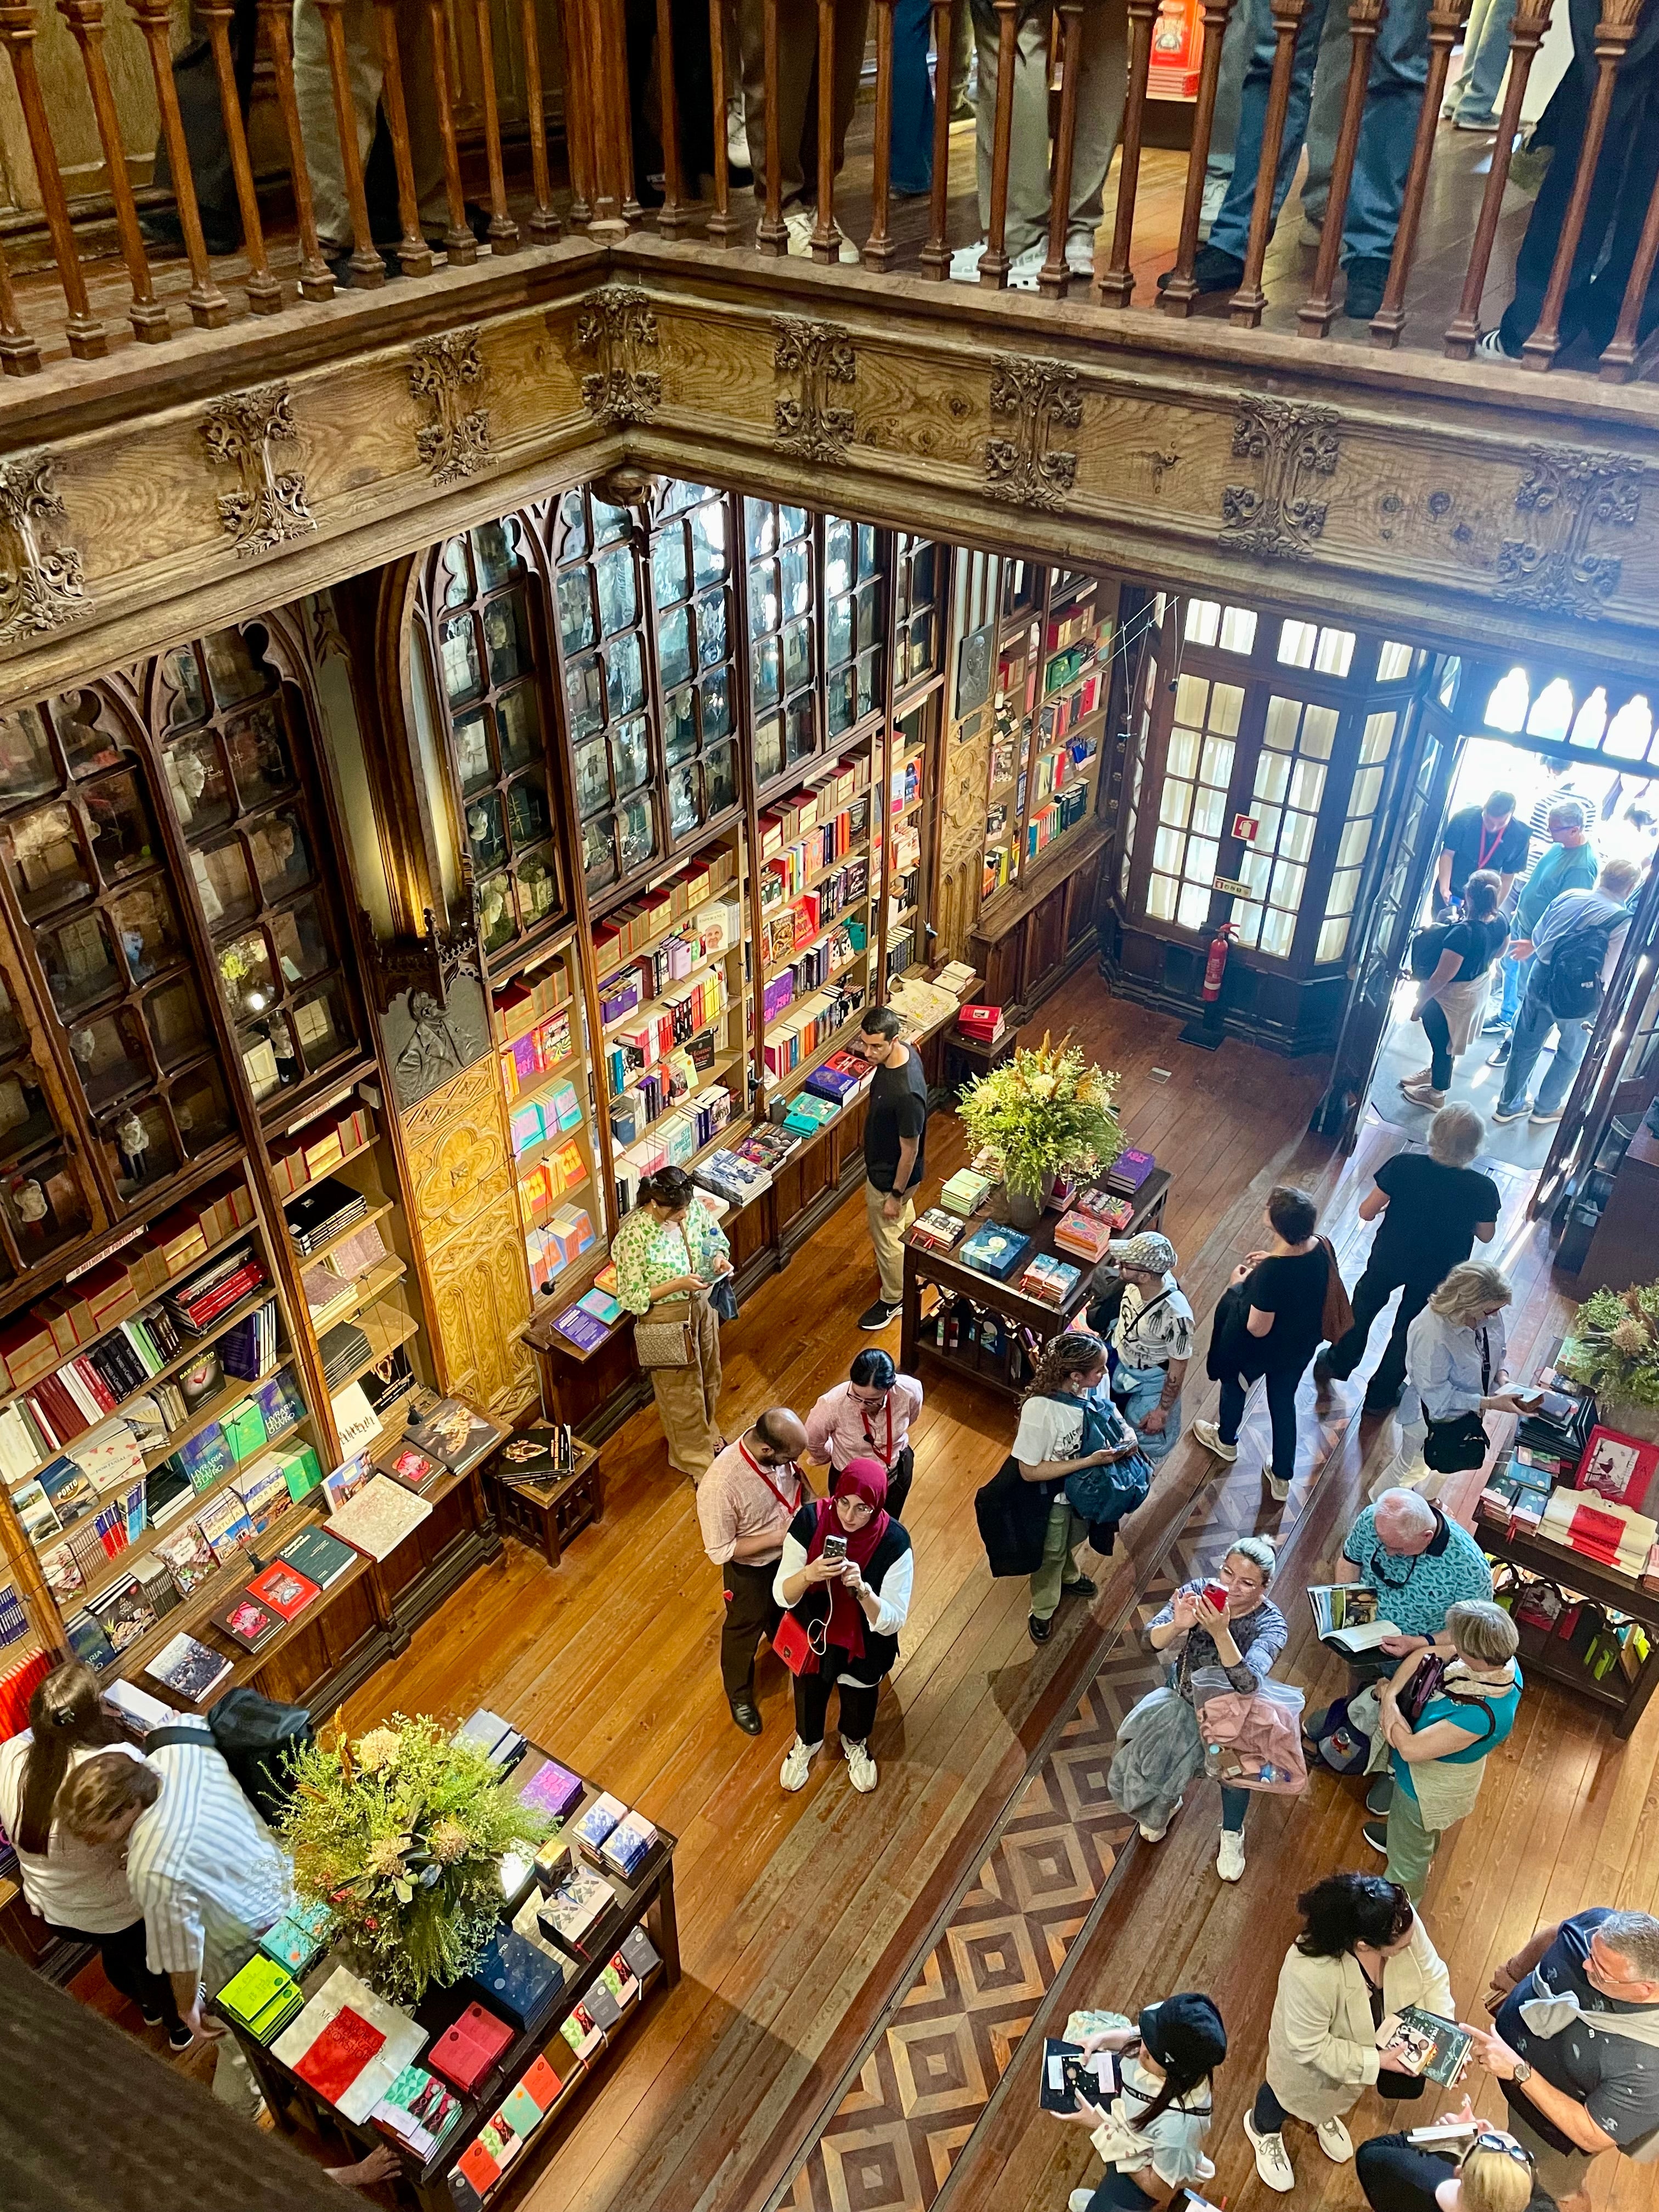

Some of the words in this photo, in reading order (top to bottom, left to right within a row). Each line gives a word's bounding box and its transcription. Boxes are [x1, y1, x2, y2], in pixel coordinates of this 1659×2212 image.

[81, 1254, 103, 1272] MELHOR
[112, 1231, 139, 1251] PORTUGAL
[179, 1368, 193, 1380] BAR
[192, 1351, 215, 1371] ABERTO
[265, 1400, 296, 1425] LIVRARIA
[95, 1455, 127, 1475] PORTUGAL
[190, 1452, 224, 1477] LIVRARIA
[57, 1479, 78, 1500] PORTO
[252, 1481, 280, 1505] PORTO
[208, 1509, 245, 1538] PORTUGAL
